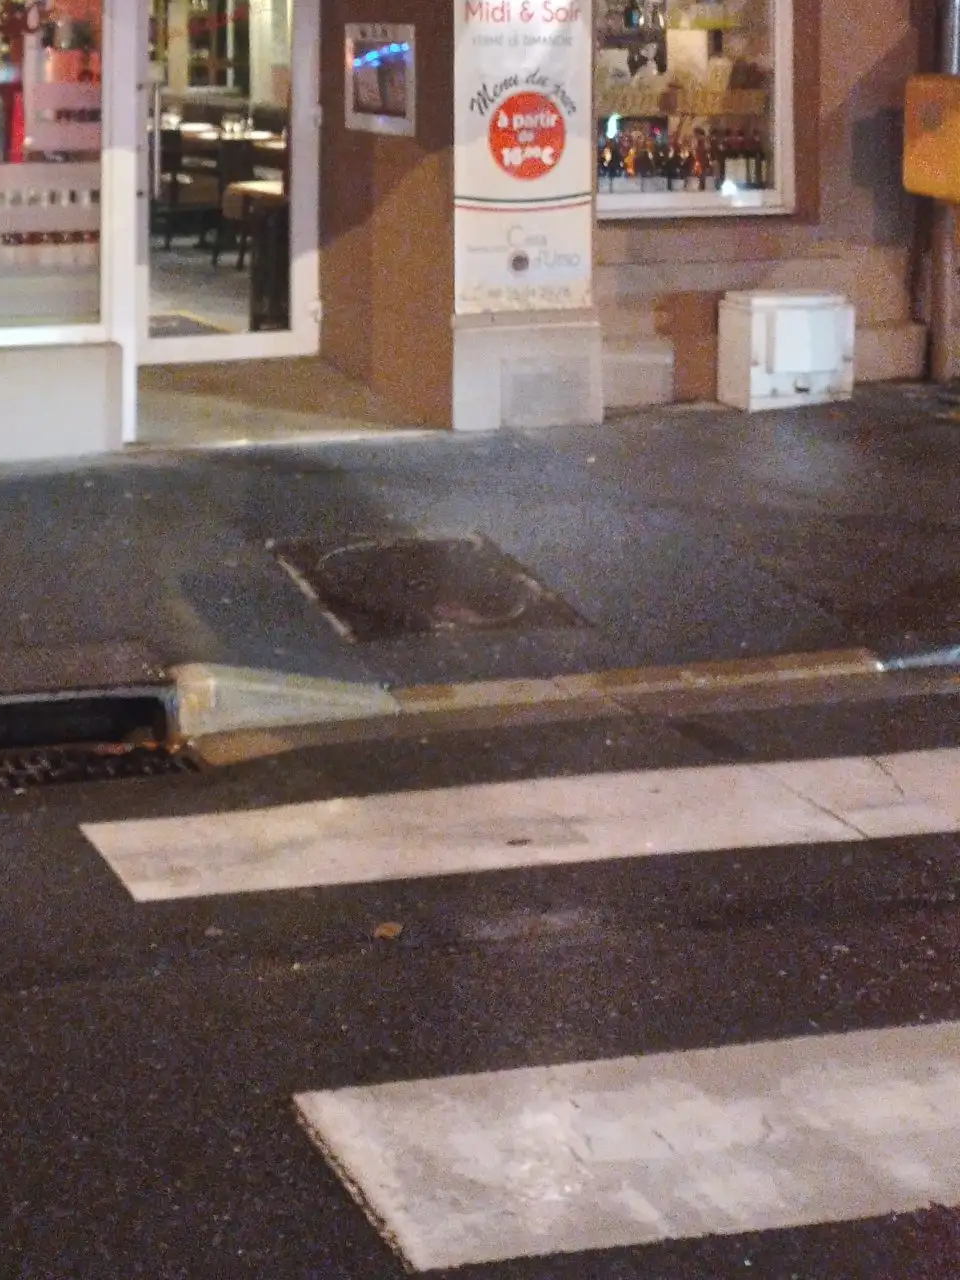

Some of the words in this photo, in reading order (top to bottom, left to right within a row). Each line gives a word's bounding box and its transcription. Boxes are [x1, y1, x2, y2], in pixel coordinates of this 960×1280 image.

[465, 0, 511, 24] Midi
[519, 0, 535, 23] &
[542, 0, 581, 23] Soir
[468, 74, 519, 116] Menu
